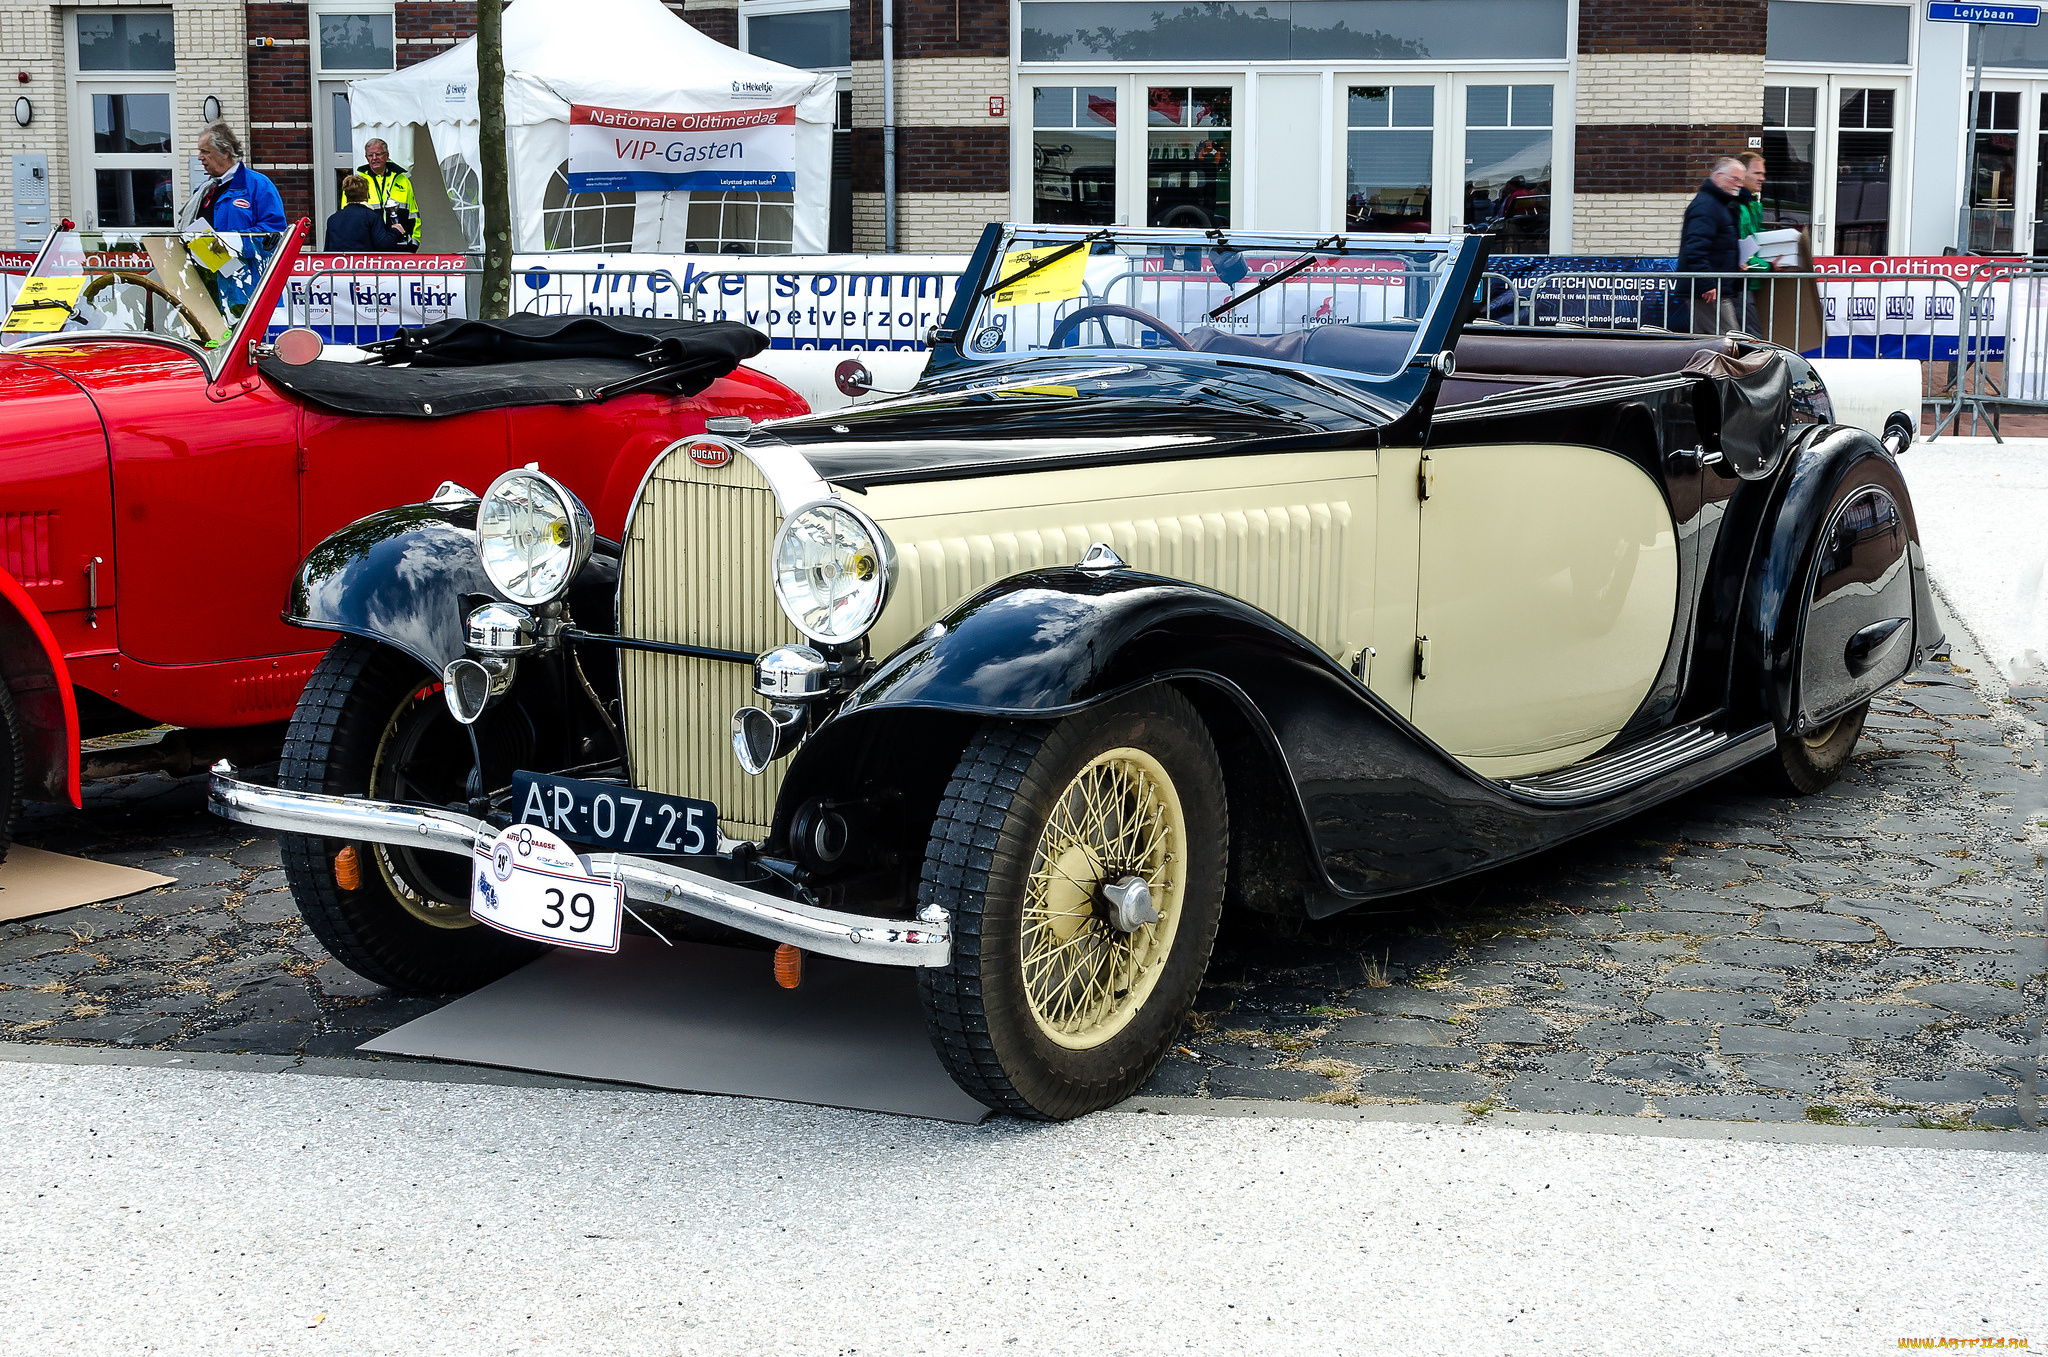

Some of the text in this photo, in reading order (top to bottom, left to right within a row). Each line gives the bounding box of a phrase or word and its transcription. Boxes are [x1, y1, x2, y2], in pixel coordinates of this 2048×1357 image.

[1954, 7, 2014, 20] Lelybaan
[589, 109, 778, 129] Nationale Oldtimerdag
[615, 138, 744, 163] VIP-Gasten
[331, 256, 465, 275] Oldtimerdag
[1551, 277, 1655, 291] TECHNOLOGIES
[691, 448, 725, 461] BUGATTI
[506, 833, 520, 842] AUTO
[518, 828, 532, 857] 8
[531, 840, 556, 850] DAAGSE
[541, 888, 595, 933] 39
